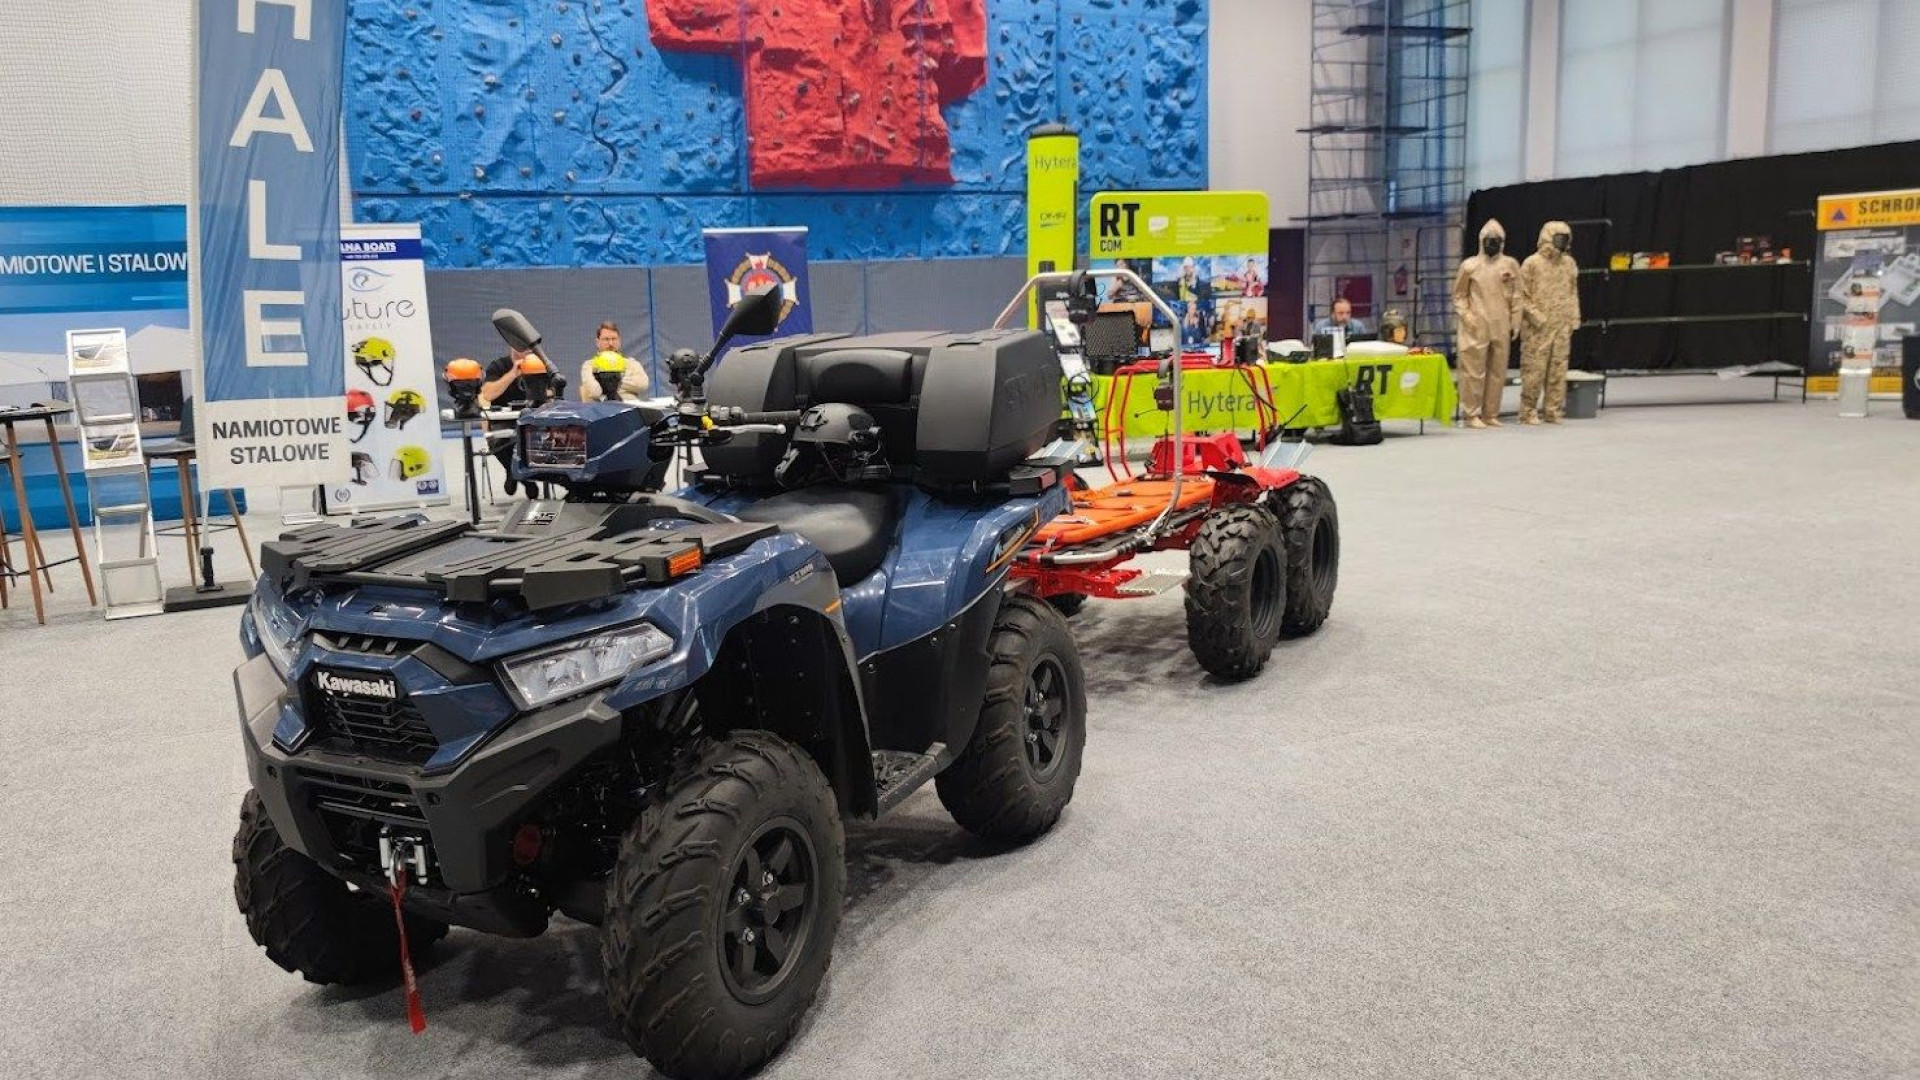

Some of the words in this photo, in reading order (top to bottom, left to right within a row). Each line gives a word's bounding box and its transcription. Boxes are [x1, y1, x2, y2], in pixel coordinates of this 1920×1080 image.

[1100, 203, 1140, 237] RT
[363, 242, 397, 252] BOATS
[1100, 239, 1122, 252] COM
[1188, 391, 1256, 419] Hytera
[212, 417, 341, 439] NAMIOTOWE
[230, 443, 329, 465] STALOWE
[317, 671, 396, 699] Kawasaki
